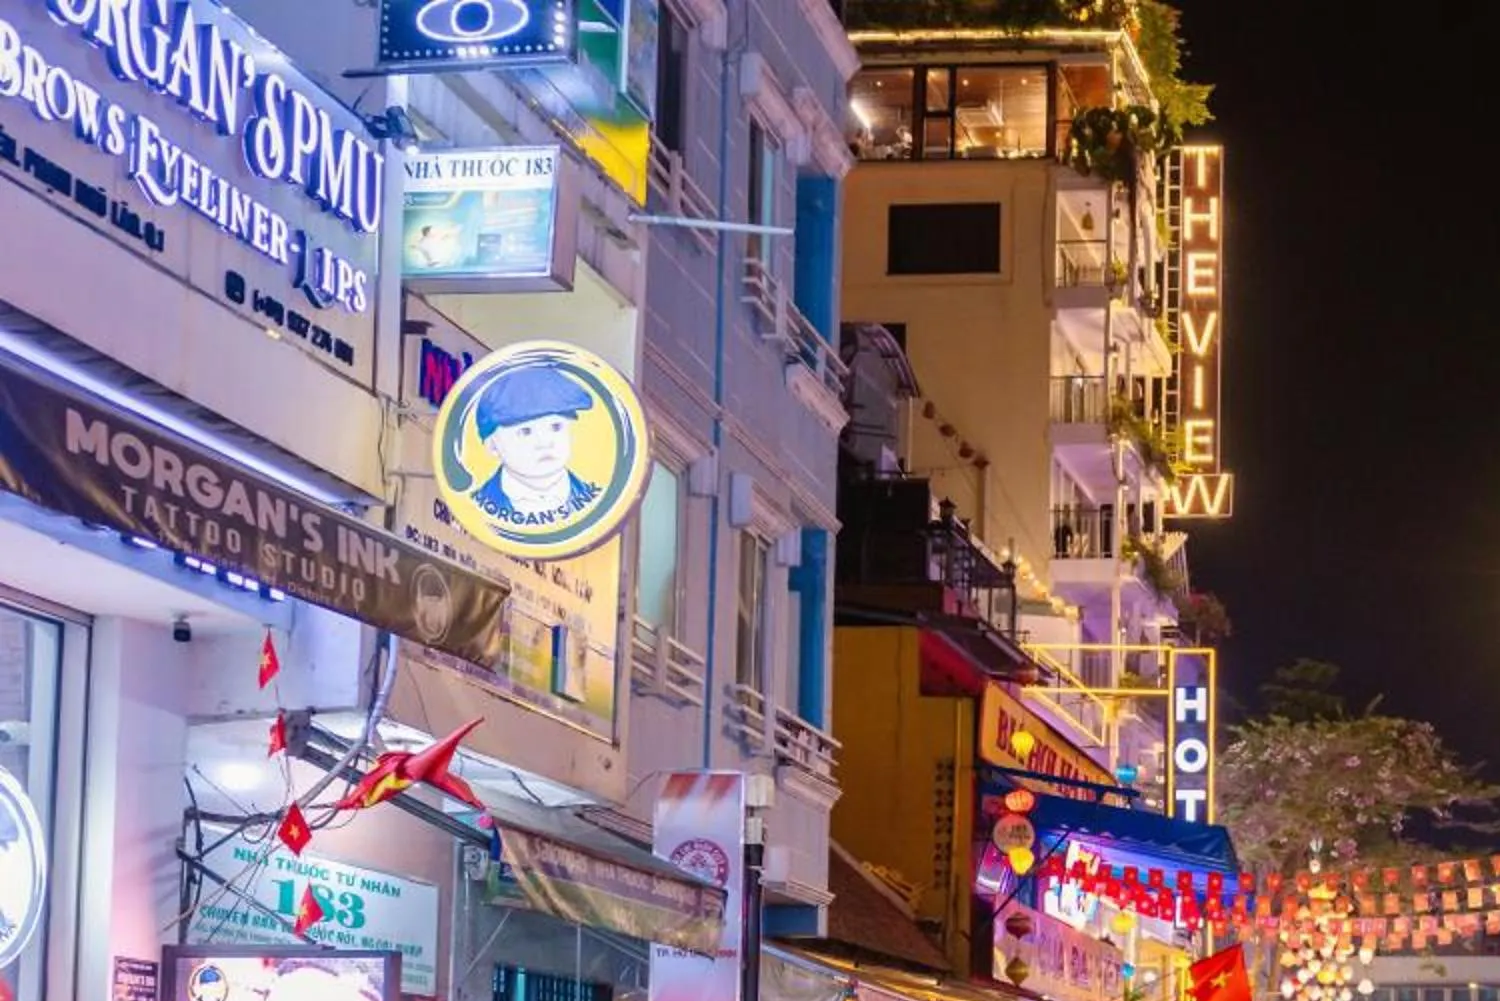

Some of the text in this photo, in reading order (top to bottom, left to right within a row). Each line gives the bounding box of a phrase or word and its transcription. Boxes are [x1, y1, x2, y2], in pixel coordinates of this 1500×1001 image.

[525, 156, 553, 176] 183
[65, 407, 323, 553] MORGAN'S
[336, 526, 400, 585] INK
[471, 488, 569, 527] MORGAN'S
[571, 481, 602, 514] INK
[121, 485, 242, 553] TATTOO
[262, 542, 366, 602] STUDIO
[272, 877, 366, 929] 183
